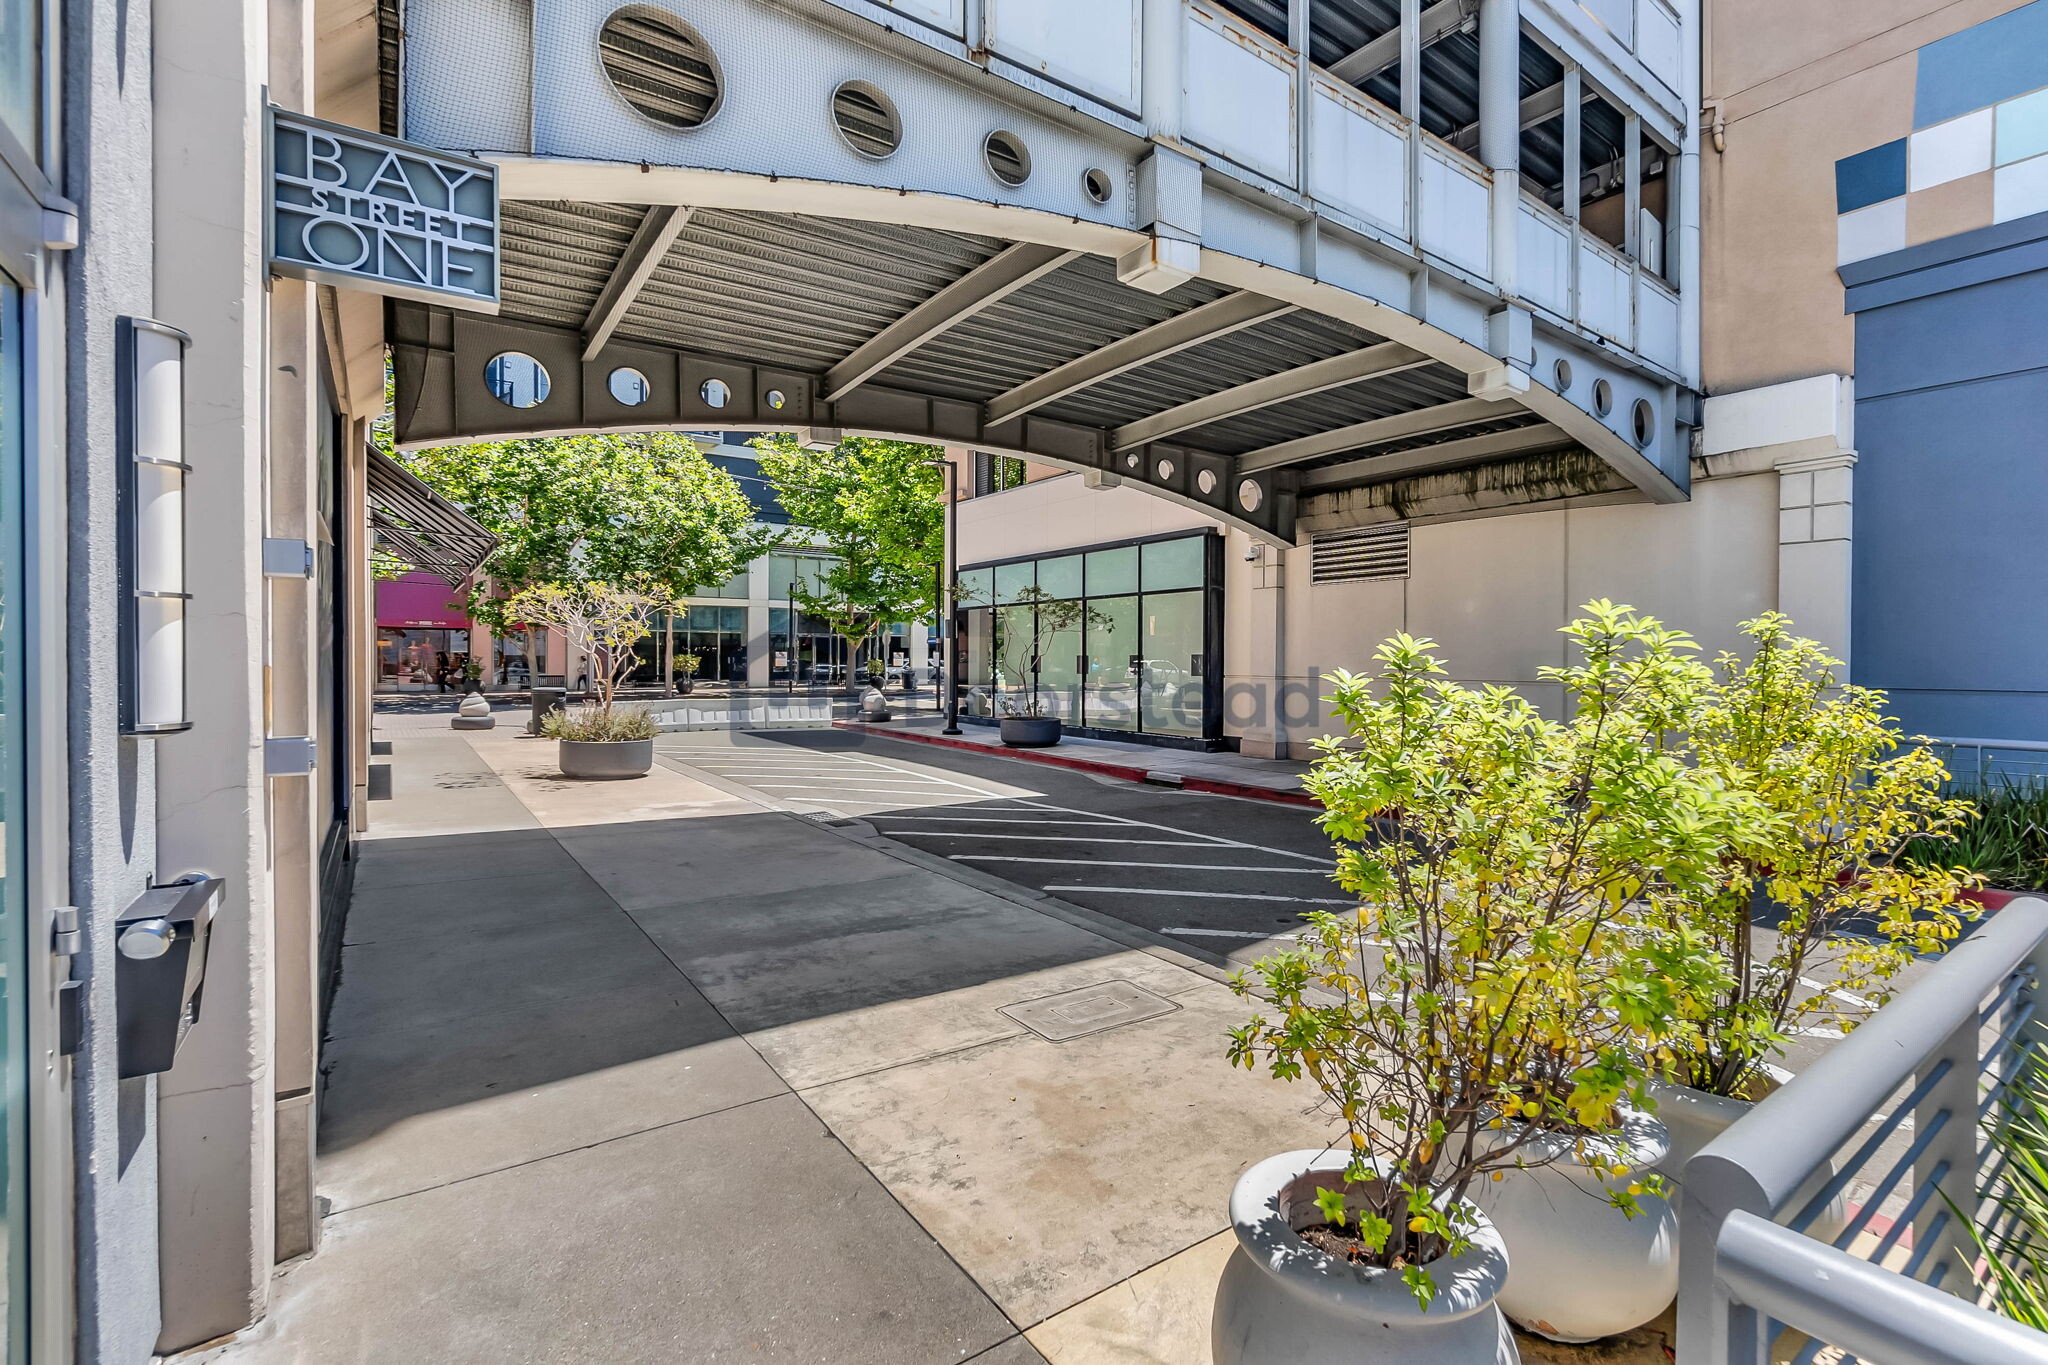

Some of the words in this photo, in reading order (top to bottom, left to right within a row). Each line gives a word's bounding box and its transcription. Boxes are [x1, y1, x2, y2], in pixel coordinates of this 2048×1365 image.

[303, 126, 476, 214] BAY
[310, 187, 472, 241] STREET
[301, 218, 476, 295] ONE
